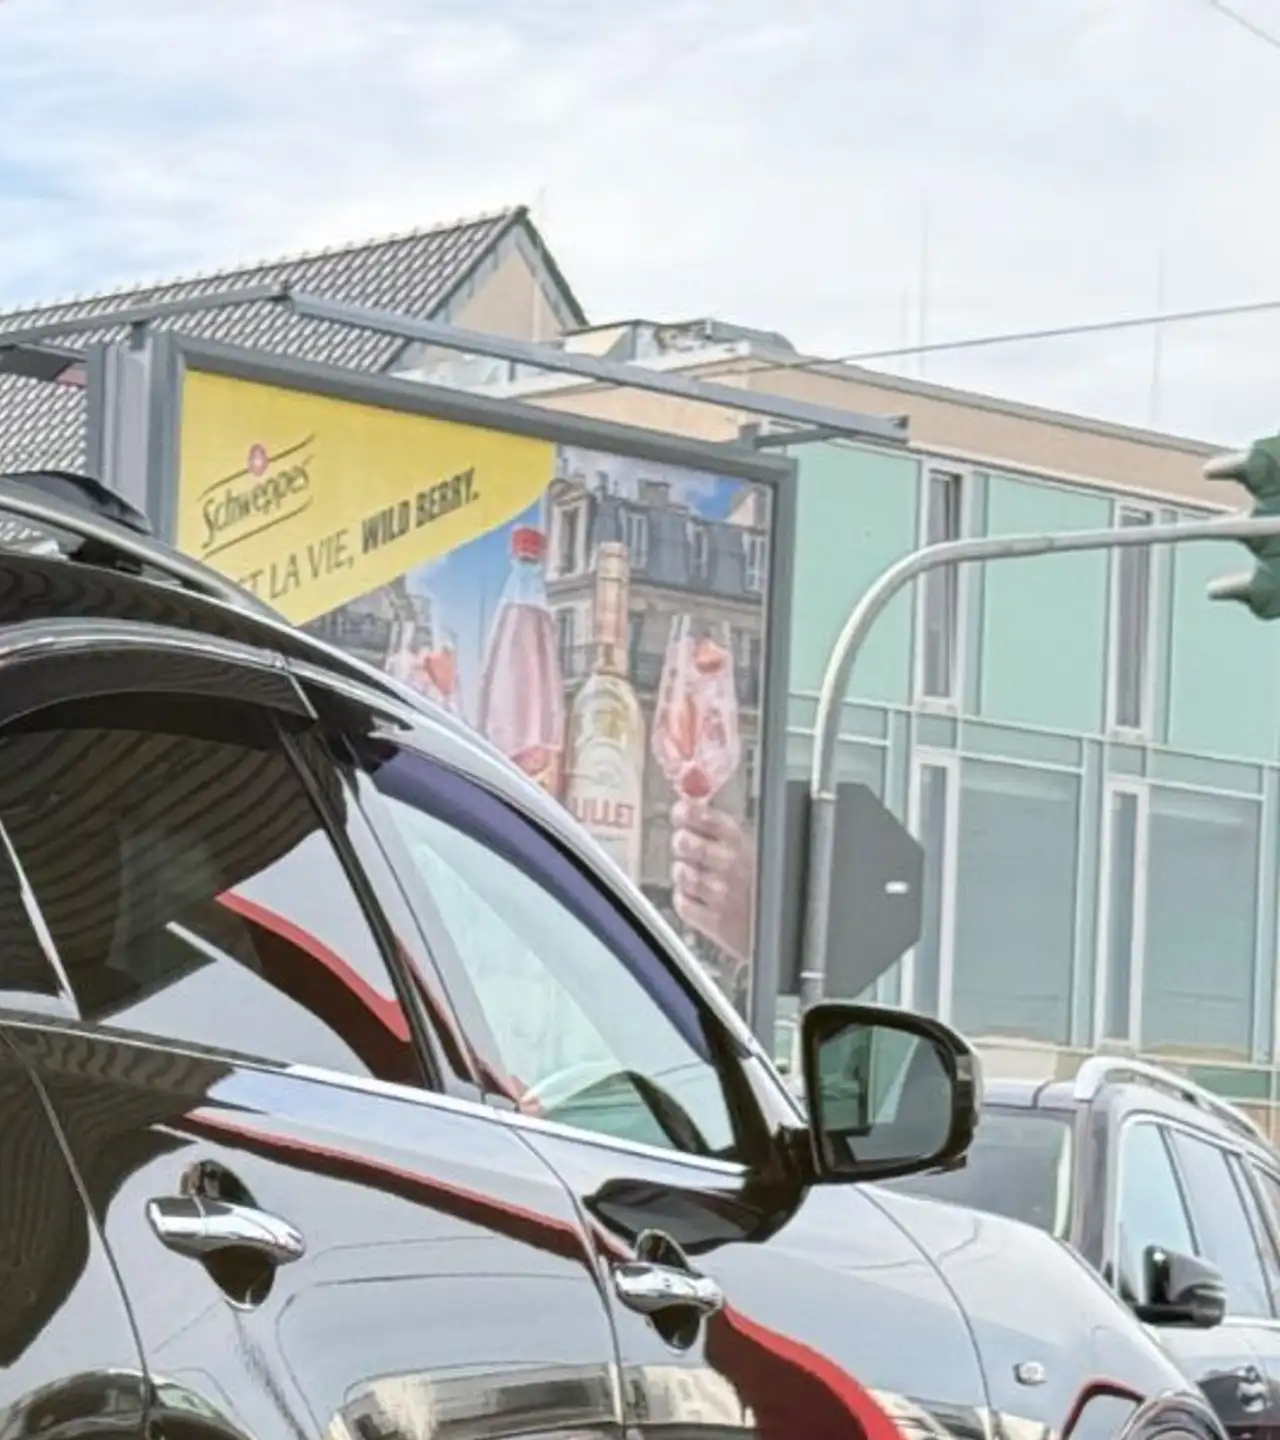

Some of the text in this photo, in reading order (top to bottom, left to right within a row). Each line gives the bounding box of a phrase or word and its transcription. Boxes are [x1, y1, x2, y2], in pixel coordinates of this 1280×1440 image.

[200, 457, 313, 550] Schweppes
[269, 553, 301, 600] LA
[307, 528, 354, 579] VIE,
[361, 500, 410, 554] WILD
[416, 466, 480, 528] BERRY.
